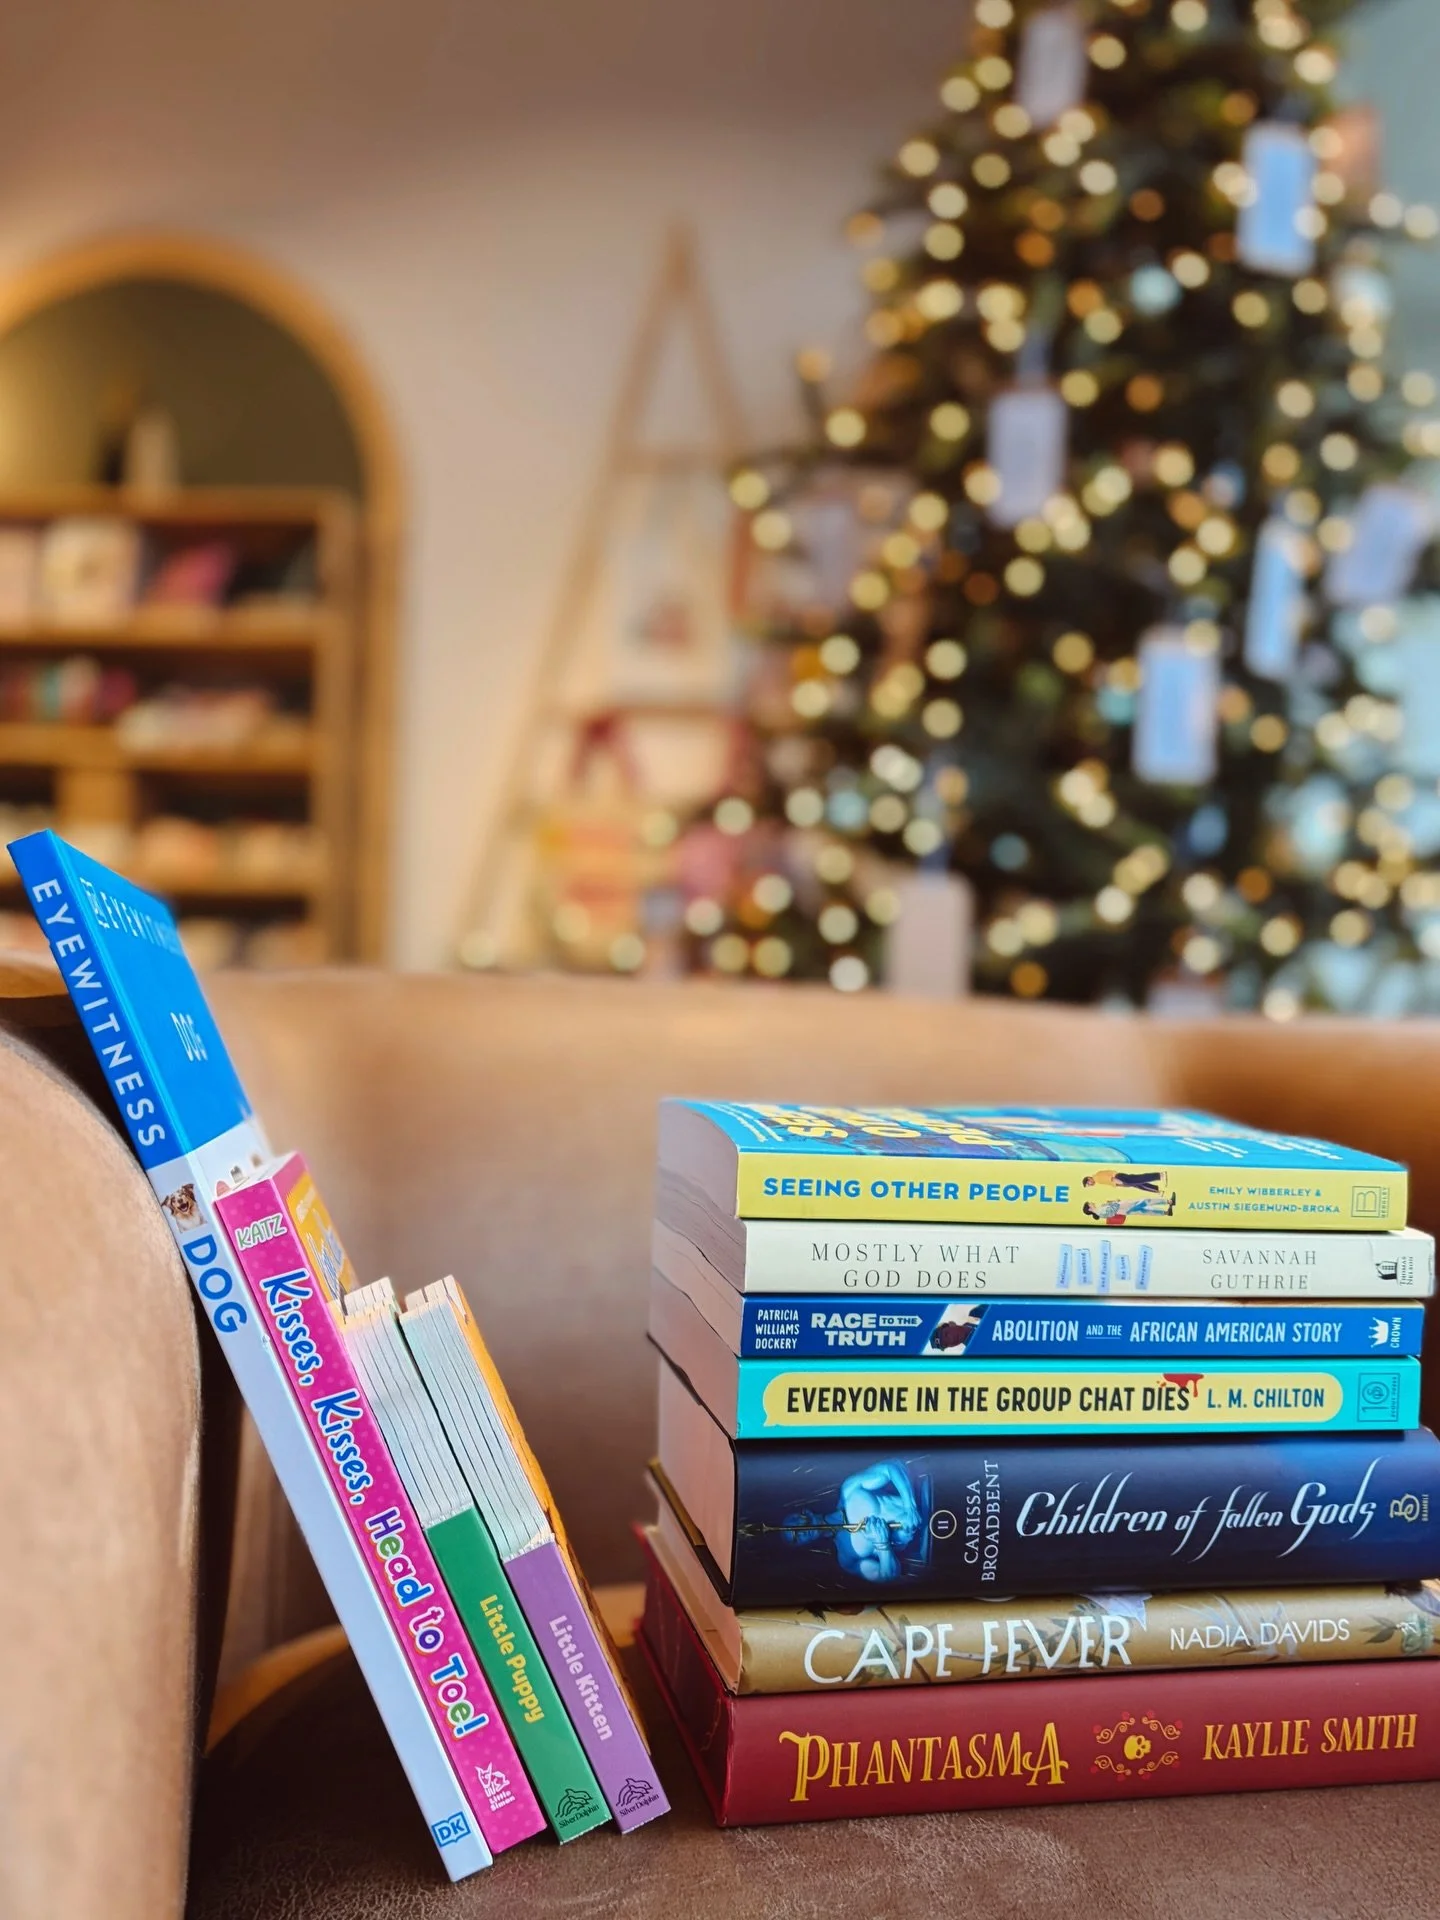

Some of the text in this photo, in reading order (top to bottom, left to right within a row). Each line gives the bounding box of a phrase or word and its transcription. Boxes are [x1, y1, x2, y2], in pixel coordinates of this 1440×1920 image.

[32, 878, 166, 1148] EYEWITNESS
[763, 1177, 1070, 1203] SEEING OTHER PEOPLE
[1209, 1186, 1243, 1195] EMILY
[1247, 1187, 1311, 1197] WIBBERLEY
[1188, 1202, 1341, 1214] AUSTIN SIEGEMUND-BROKA
[235, 1213, 288, 1251] KATZ
[812, 1242, 1020, 1265] MOSTLY WHAT
[1203, 1250, 1317, 1266] SAVANNAH
[182, 1233, 248, 1333] DOG
[843, 1269, 987, 1289] GOD DOES
[1210, 1274, 1308, 1290] GUTHRIE
[757, 1309, 799, 1321] PATRICIA
[811, 1313, 918, 1328] RACE TO THE
[755, 1323, 800, 1335] WILLIAMS
[824, 1331, 906, 1346] TRUTH
[992, 1320, 1343, 1342] ABOLITION AND THE AFRICAN AMERICAN STORY
[1390, 1316, 1402, 1348] CROWN
[755, 1338, 798, 1349] DOCKERY
[787, 1386, 1190, 1412] EVERYONE IN THE GROUP CHAT DIES
[1207, 1388, 1325, 1408] L. M. CHILTON
[260, 1268, 490, 1739] Kisses, Kisses, Head to Toe!
[1016, 1455, 1386, 1563] Children of fallen Gods
[964, 1479, 981, 1564] CARISSA
[981, 1460, 1000, 1581] BROADBENT
[1170, 1618, 1351, 1651] NADIA DAVIDS
[480, 1594, 545, 1723] Little Puppy
[804, 1614, 1132, 1684] CAPE FEVER
[549, 1615, 613, 1741] Little Kitten
[1203, 1713, 1418, 1760] KAYLIE SMITH
[778, 1722, 1069, 1802] PHANTASMA
[489, 1791, 511, 1804] Little
[489, 1796, 516, 1812] Simon
[438, 1817, 464, 1842] DK
